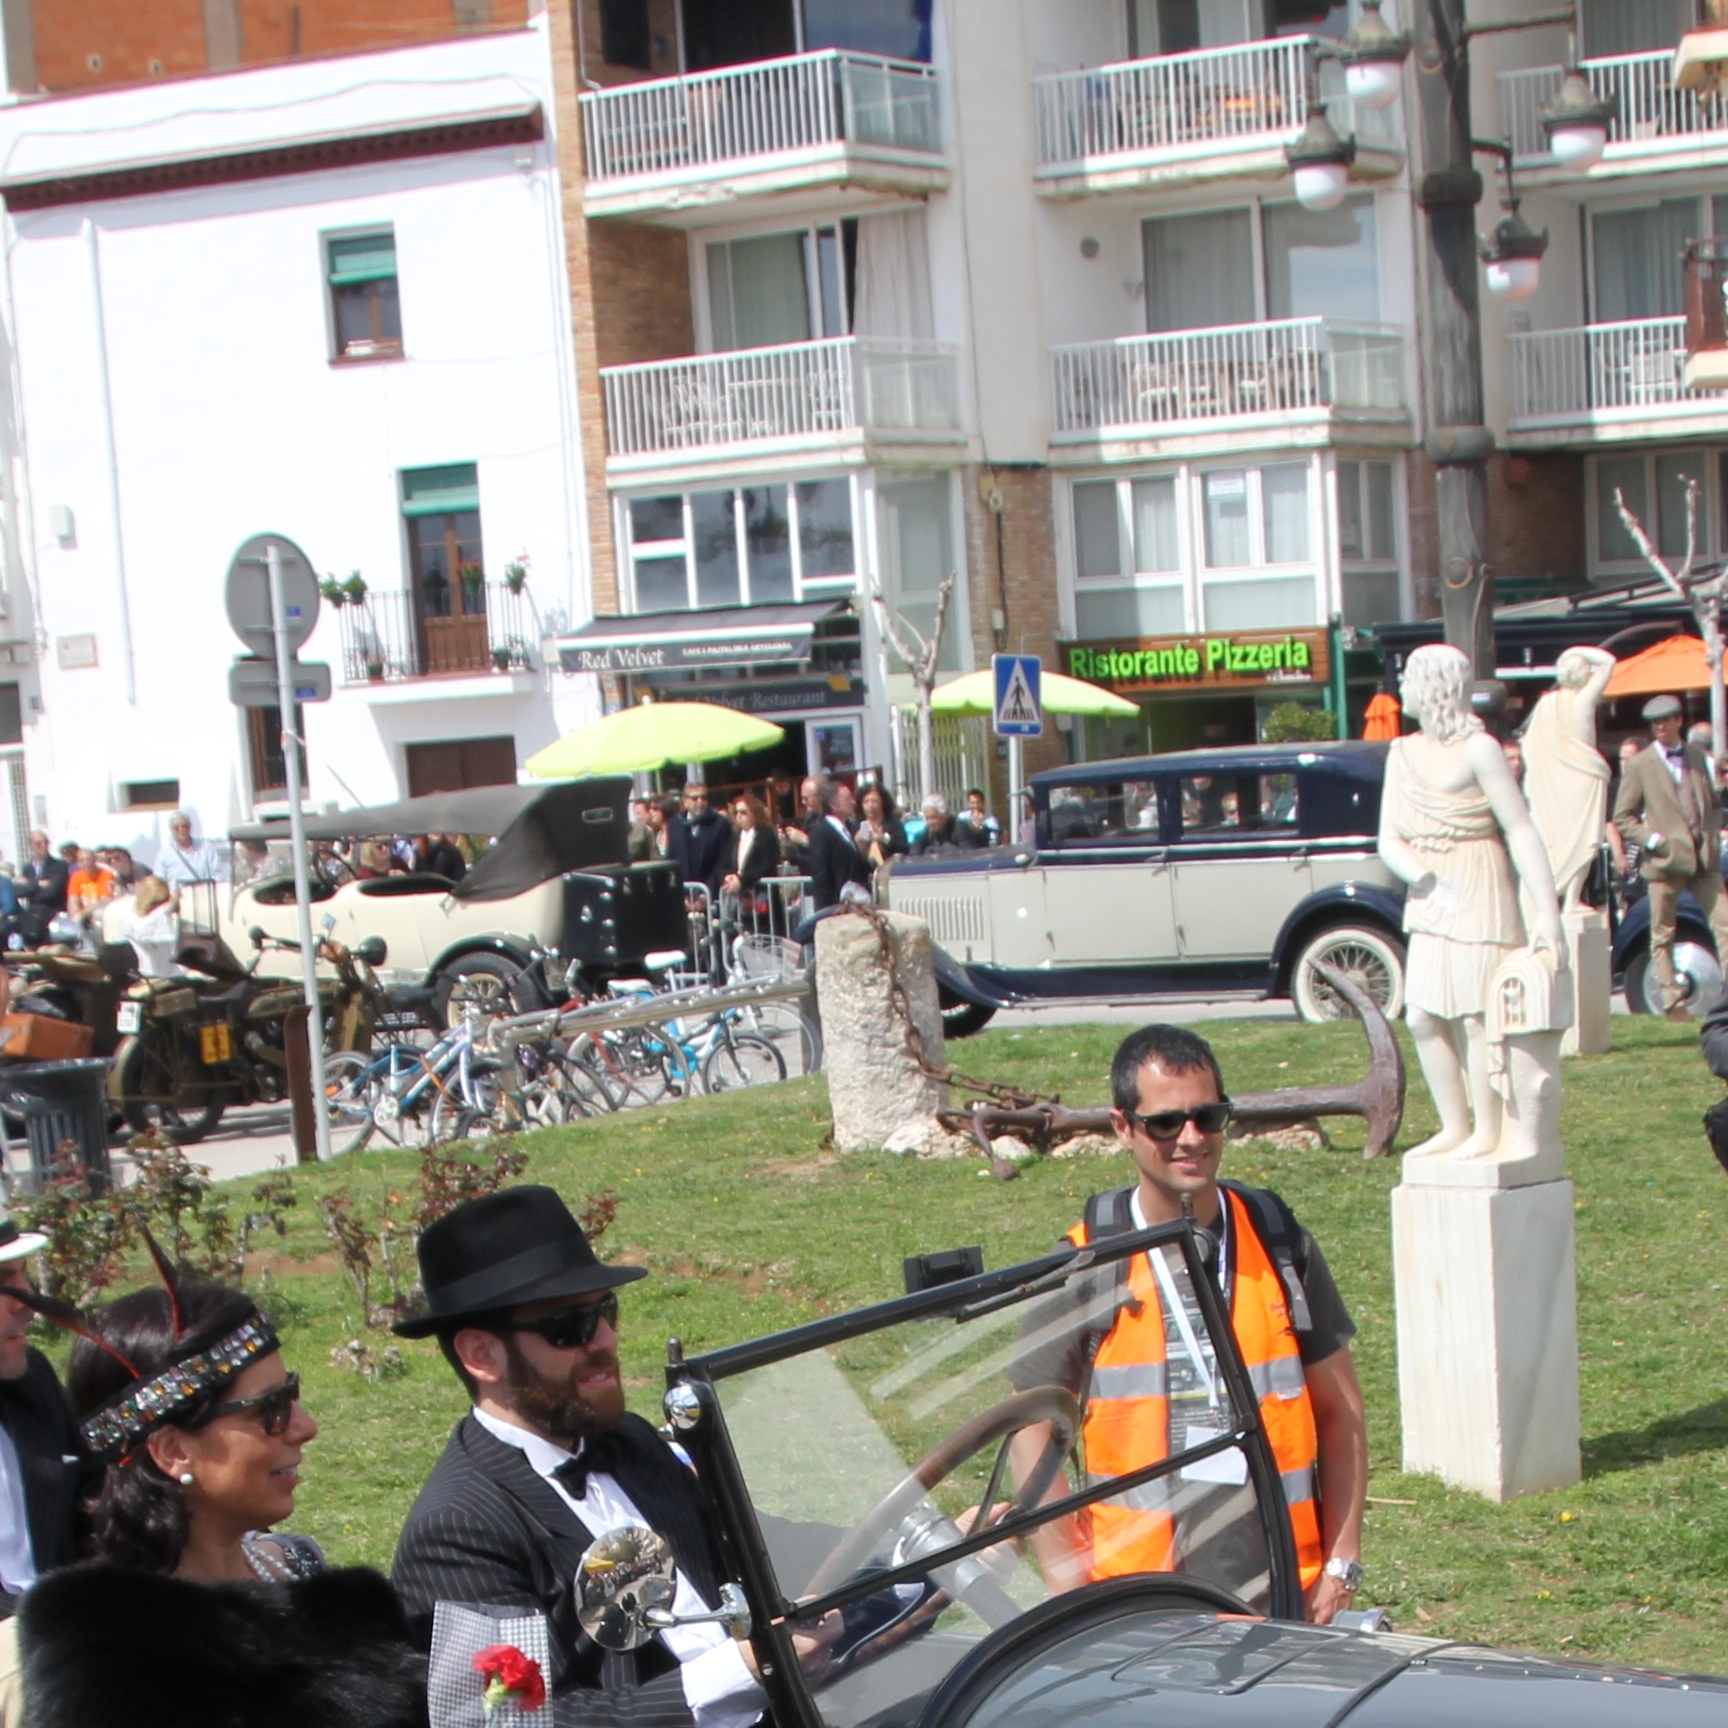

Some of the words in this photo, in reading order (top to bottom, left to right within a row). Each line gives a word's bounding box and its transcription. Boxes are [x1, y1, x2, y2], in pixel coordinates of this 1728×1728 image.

[578, 645, 611, 670] Red
[615, 643, 664, 668] Velvet
[1069, 642, 1199, 679] Ristorante
[1205, 635, 1309, 672] Pizzeria
[749, 689, 826, 709] Restaurant
